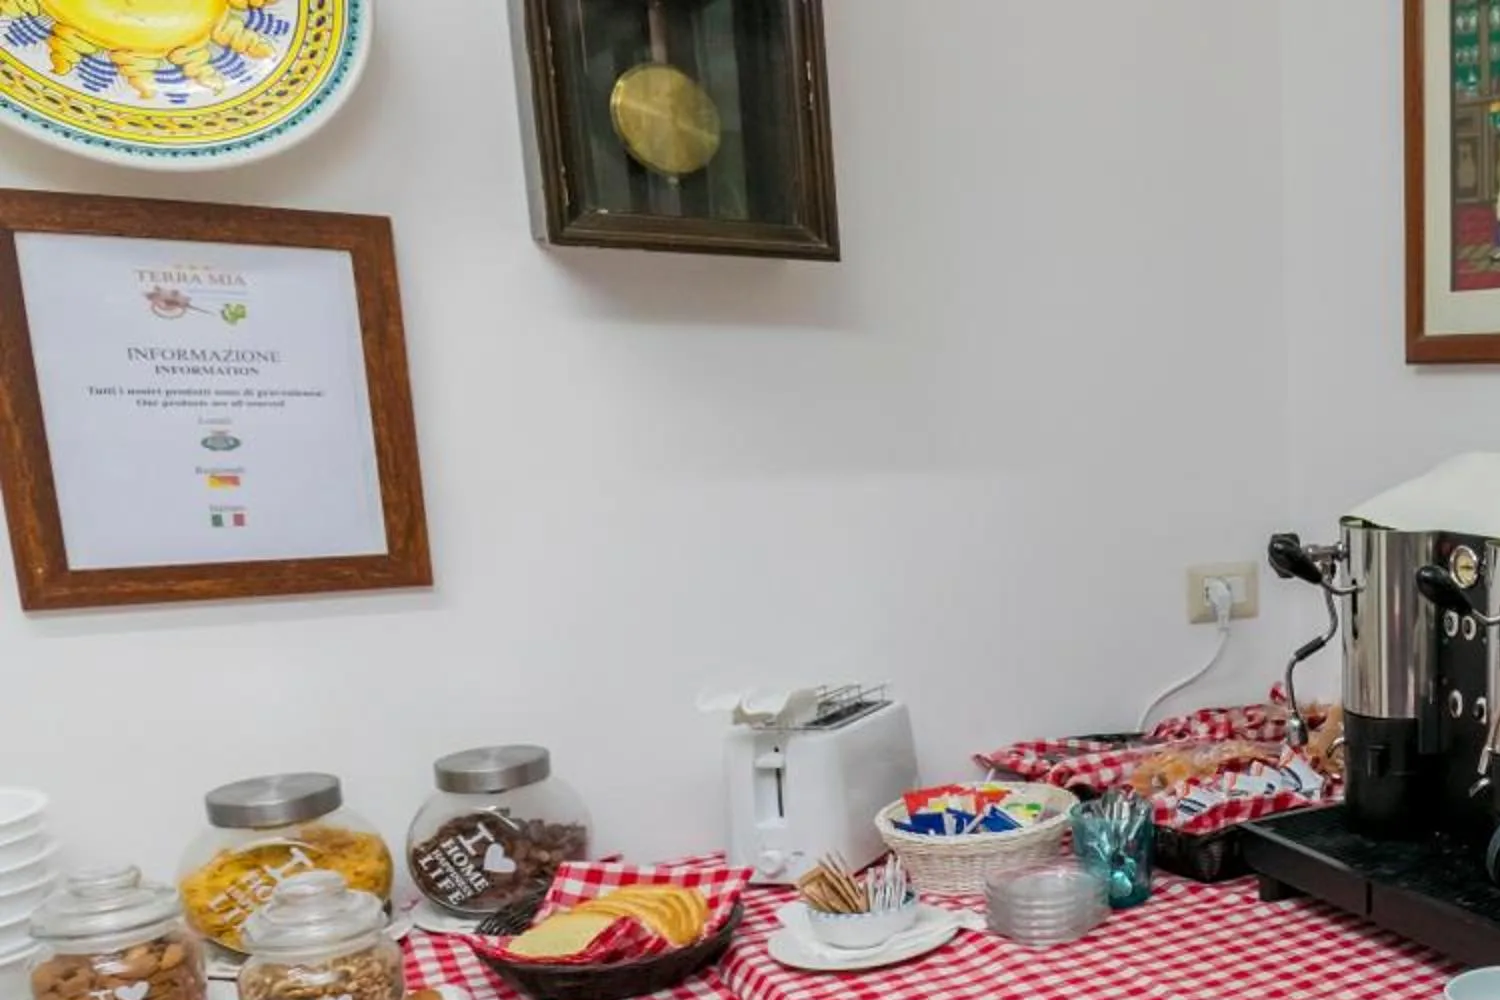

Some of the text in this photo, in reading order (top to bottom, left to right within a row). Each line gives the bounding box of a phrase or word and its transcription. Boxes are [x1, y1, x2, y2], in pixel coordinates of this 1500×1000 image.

[134, 269, 248, 287] TERRA MIA
[127, 347, 282, 363] INFORMAZIONE
[154, 365, 260, 376] INFORMATION
[457, 822, 495, 856] I
[441, 839, 489, 892] HOME
[418, 853, 465, 905] LIFE
